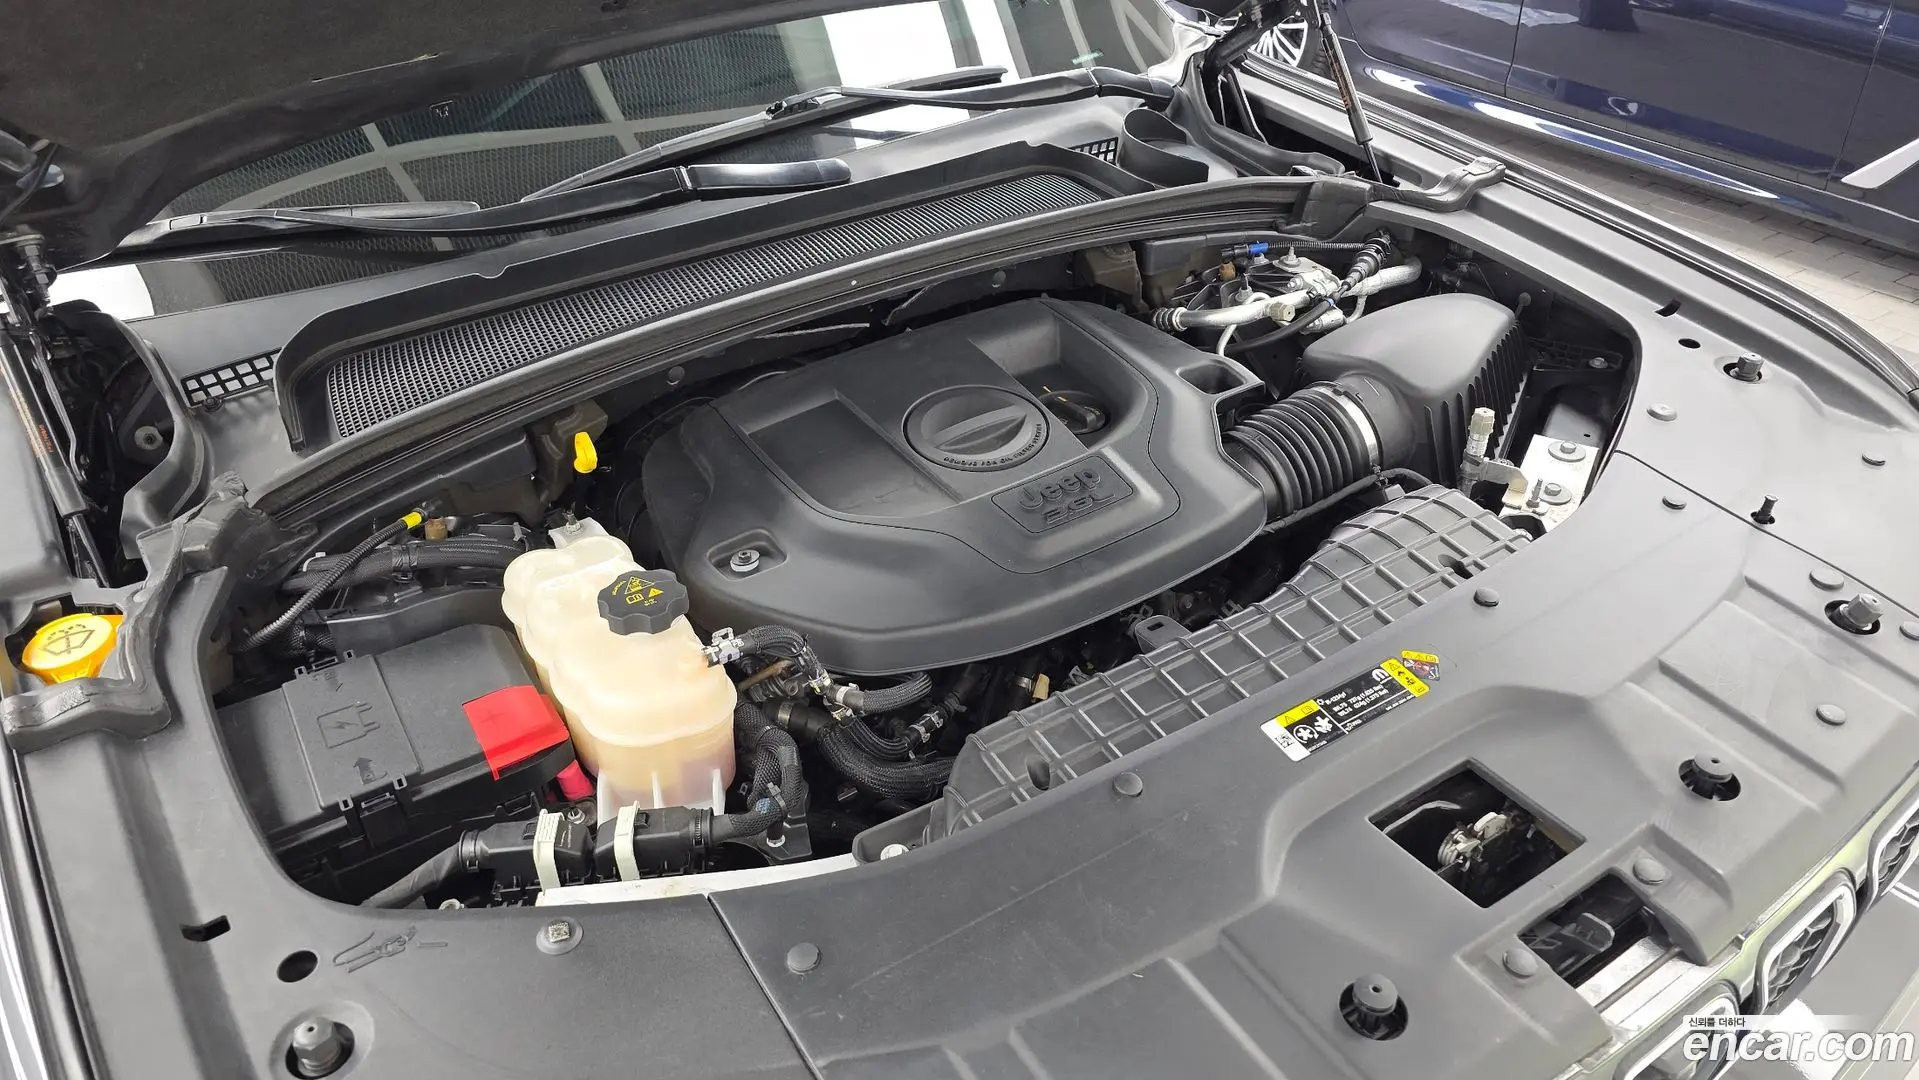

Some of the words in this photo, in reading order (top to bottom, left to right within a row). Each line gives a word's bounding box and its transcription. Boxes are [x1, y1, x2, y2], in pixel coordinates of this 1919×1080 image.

[1000, 455, 1014, 464] OIL
[1013, 443, 1035, 459] FILTER
[1019, 470, 1101, 510] Jeep
